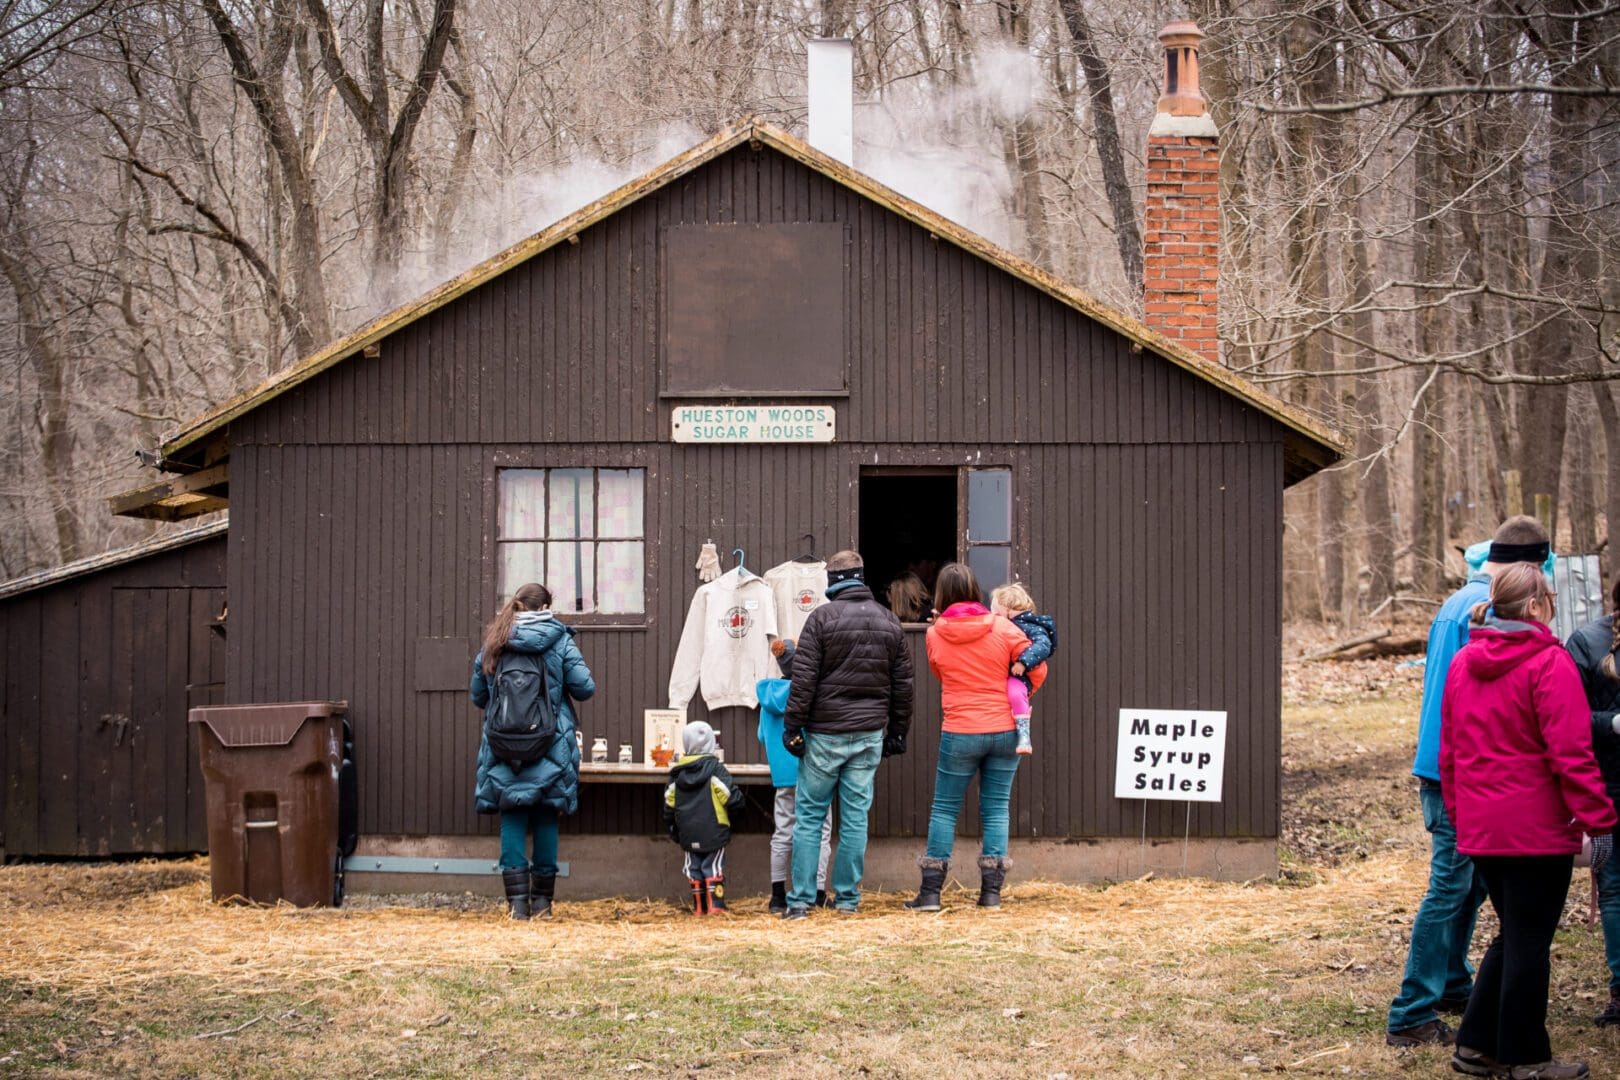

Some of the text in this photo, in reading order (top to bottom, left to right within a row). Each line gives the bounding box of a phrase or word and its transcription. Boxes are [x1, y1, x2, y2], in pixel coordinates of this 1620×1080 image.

[682, 409, 826, 423] HUESTON WOODS
[693, 425, 815, 439] SUGAR HOUSE
[1130, 719, 1214, 741] Maple
[1133, 746, 1211, 769] Syrup
[1134, 773, 1207, 792] Sales
